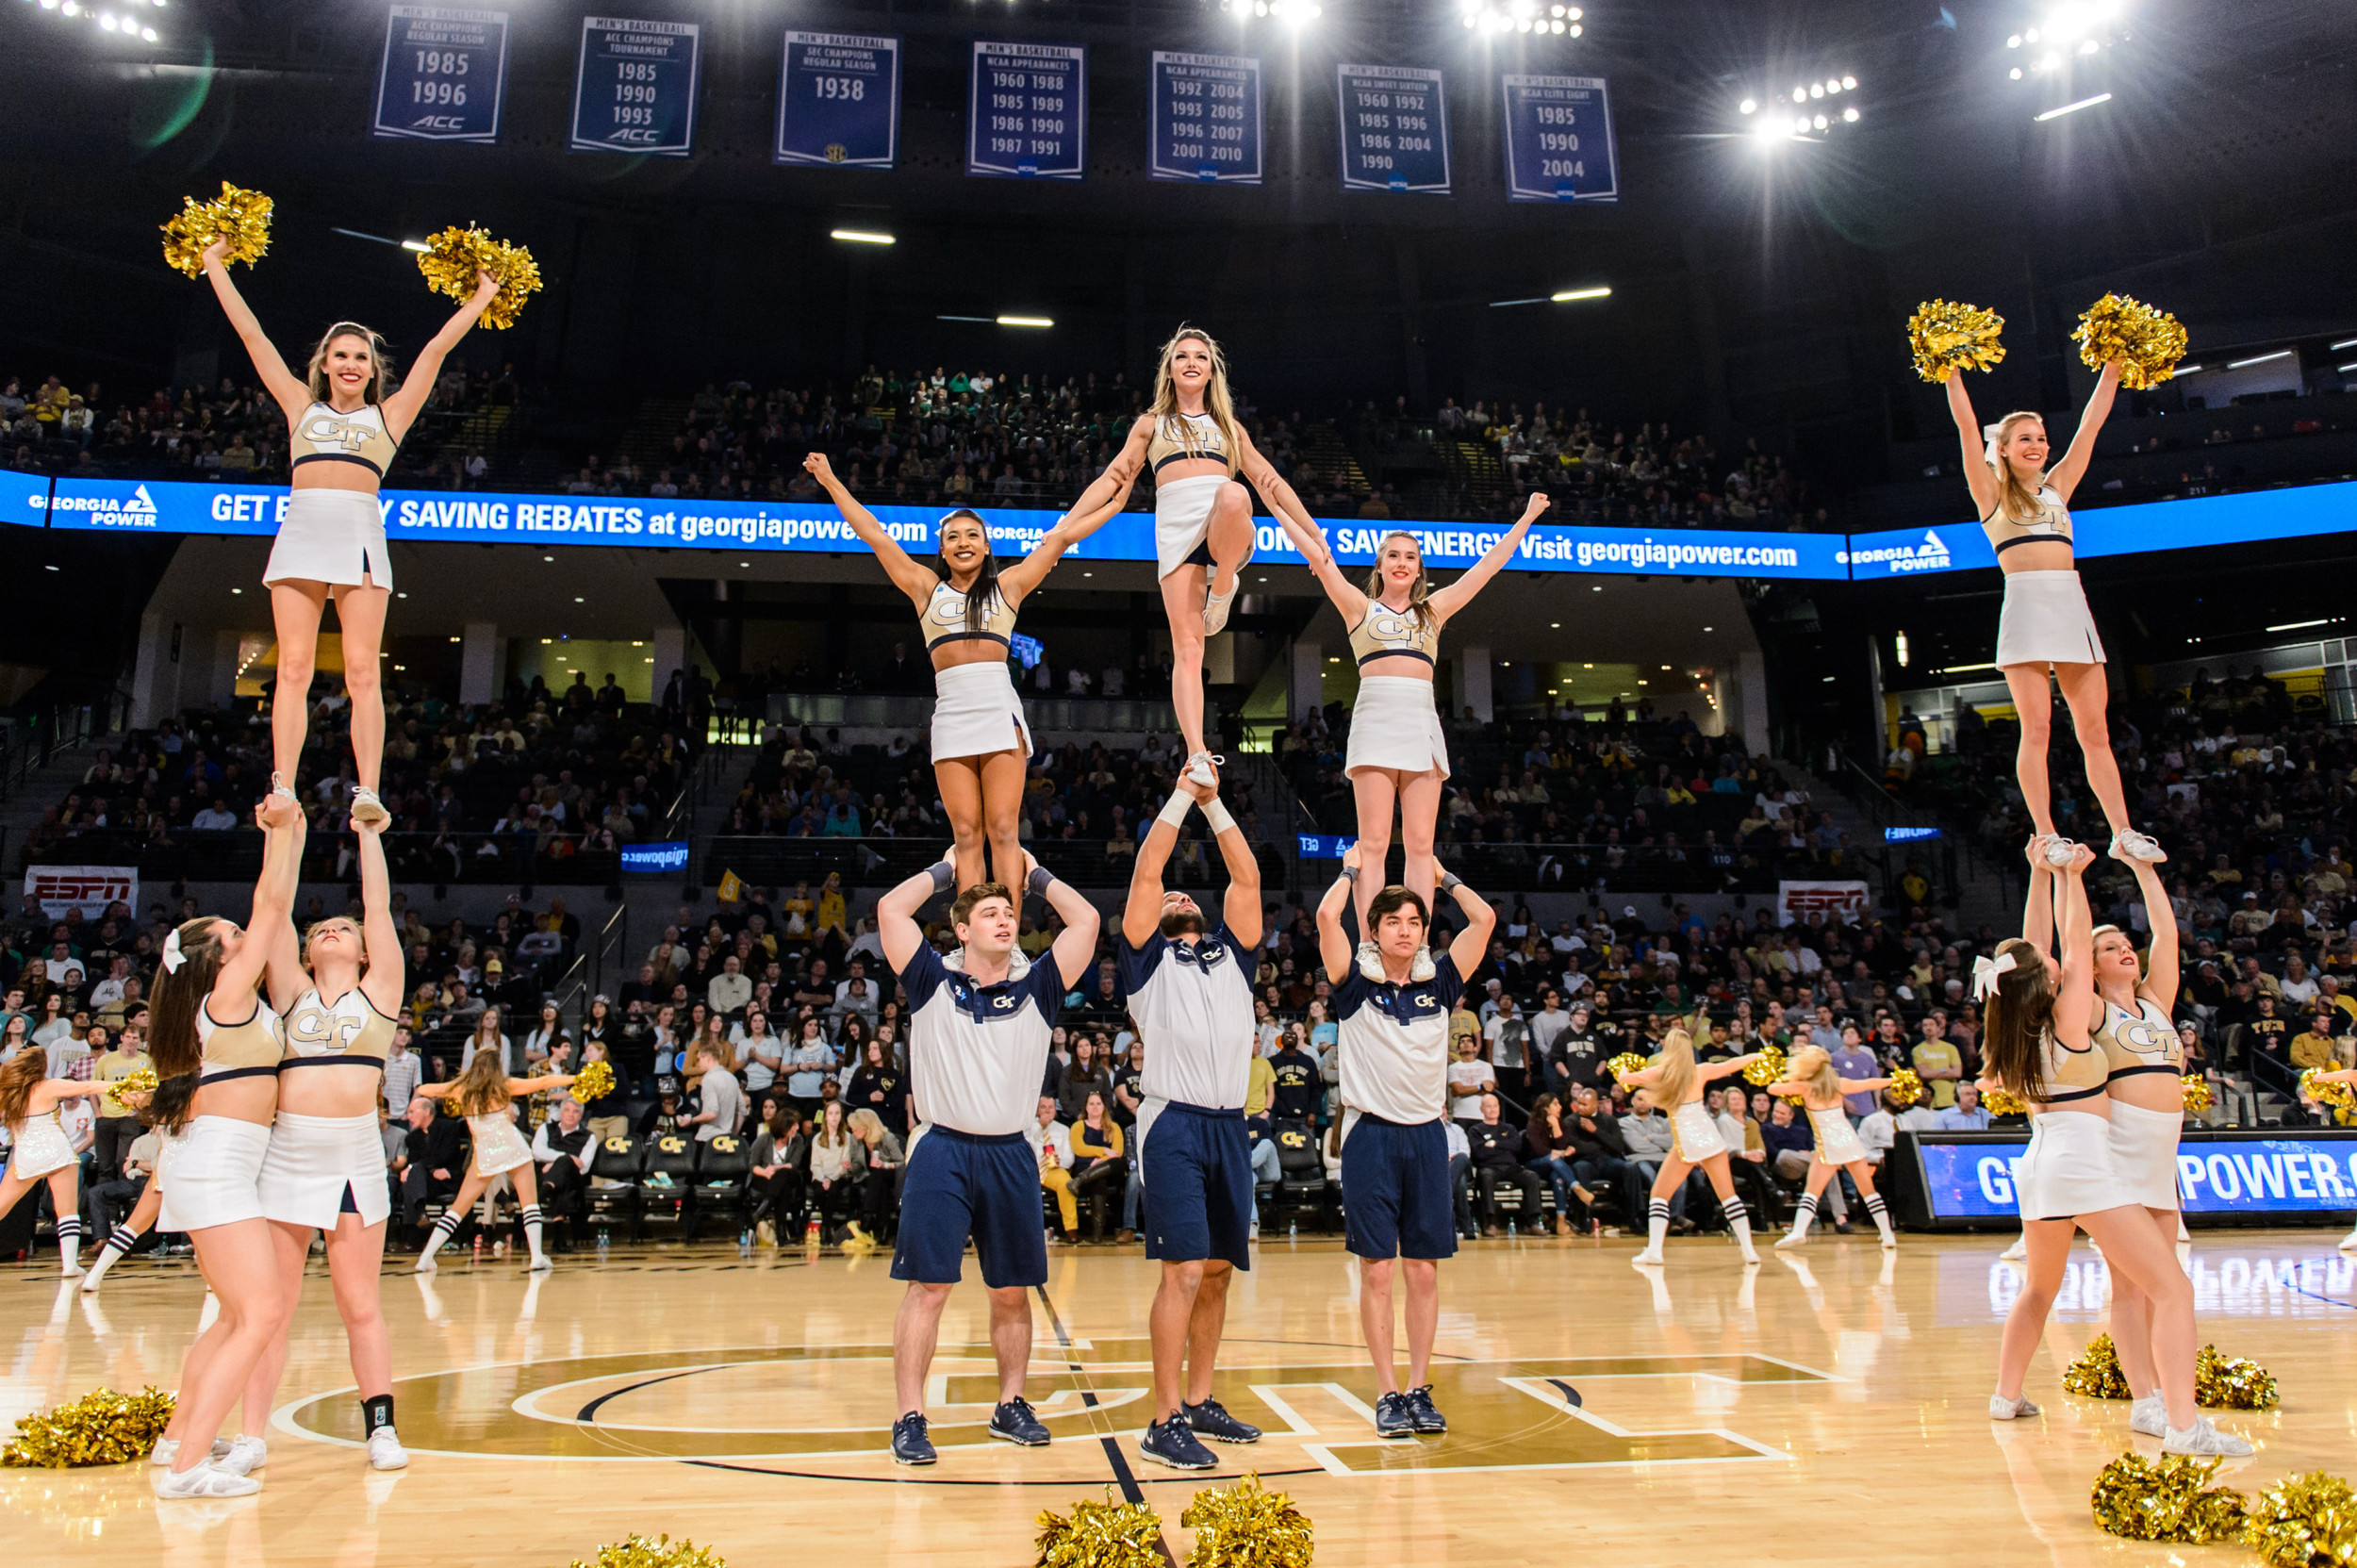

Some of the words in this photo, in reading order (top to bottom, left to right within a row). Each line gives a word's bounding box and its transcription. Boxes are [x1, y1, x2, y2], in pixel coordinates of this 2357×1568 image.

[430, 22, 484, 33] CHAMPIONS
[596, 19, 625, 29] MEN'S
[628, 21, 686, 34] BASKETBALL
[406, 30, 448, 41] REGULAR
[450, 33, 486, 43] SEASON
[605, 33, 621, 42] ACC
[623, 34, 674, 46] CHAMPIONS
[797, 33, 826, 44] MEN'S
[829, 35, 885, 48] BASKETBALL
[610, 43, 668, 56] TOURNAMENT
[807, 47, 822, 57] SEC
[824, 48, 874, 60] CHAMPIONS
[985, 44, 1014, 55] MEN'S
[1016, 45, 1071, 57] BASKETBALL
[417, 50, 470, 75] 1985
[802, 58, 842, 68] REGULAR
[844, 59, 877, 71] SEASON
[987, 57, 1010, 67] NCAA
[1012, 58, 1070, 71] APPEARANCES
[618, 62, 656, 81] 1985
[1165, 65, 1187, 75] NCAA
[1190, 67, 1247, 80] APPEARANCES
[815, 76, 865, 101] 1938
[993, 73, 1026, 88] 1960
[1032, 74, 1063, 90] 1988
[1172, 80, 1202, 96] 1992
[1211, 83, 1244, 99] 2004
[1399, 81, 1428, 91] SIXTEEN
[413, 81, 467, 106] 1996
[616, 84, 656, 103] 1990
[1358, 93, 1389, 107] 1960
[1395, 95, 1425, 110] 1992
[993, 94, 1024, 109] 1985
[1031, 97, 1063, 112] 1989
[1172, 101, 1202, 117] 1993
[1211, 104, 1244, 120] 2005
[412, 115, 467, 129] ACC
[613, 106, 652, 125] 1993
[1359, 113, 1389, 128] 1985
[1396, 115, 1426, 131] 1996
[1537, 107, 1574, 124] 1985
[992, 115, 1024, 131] 1986
[1031, 118, 1063, 134] 1990
[1172, 122, 1203, 138] 1996
[1211, 124, 1244, 140] 2007
[608, 128, 660, 141] ACC
[1360, 134, 1392, 149] 1986
[1398, 136, 1431, 151] 2004
[1539, 133, 1579, 151] 1990
[991, 138, 1022, 153] 1987
[1030, 140, 1061, 156] 1991
[1172, 143, 1203, 158] 2001
[1211, 146, 1243, 161] 2010
[1362, 155, 1393, 170] 1990
[1541, 159, 1584, 177] 2004
[28, 495, 120, 513] GEORGIA
[211, 493, 271, 522] GET
[91, 512, 157, 527] POWER
[399, 500, 509, 530] SAVING
[516, 503, 644, 534] REBATES
[648, 512, 675, 535] at
[986, 528, 1044, 540] EORGIA
[1519, 534, 1574, 561] Visit
[1576, 537, 1798, 568] georgiapower.com
[1836, 546, 1914, 564] GEORGIA
[1890, 554, 1951, 572] POWER
[1714, 855, 1731, 865] 110
[35, 876, 131, 900] ESPN
[1786, 890, 1864, 910] ESPN
[993, 996, 1015, 1008] GT
[1415, 995, 1436, 1007] GT
